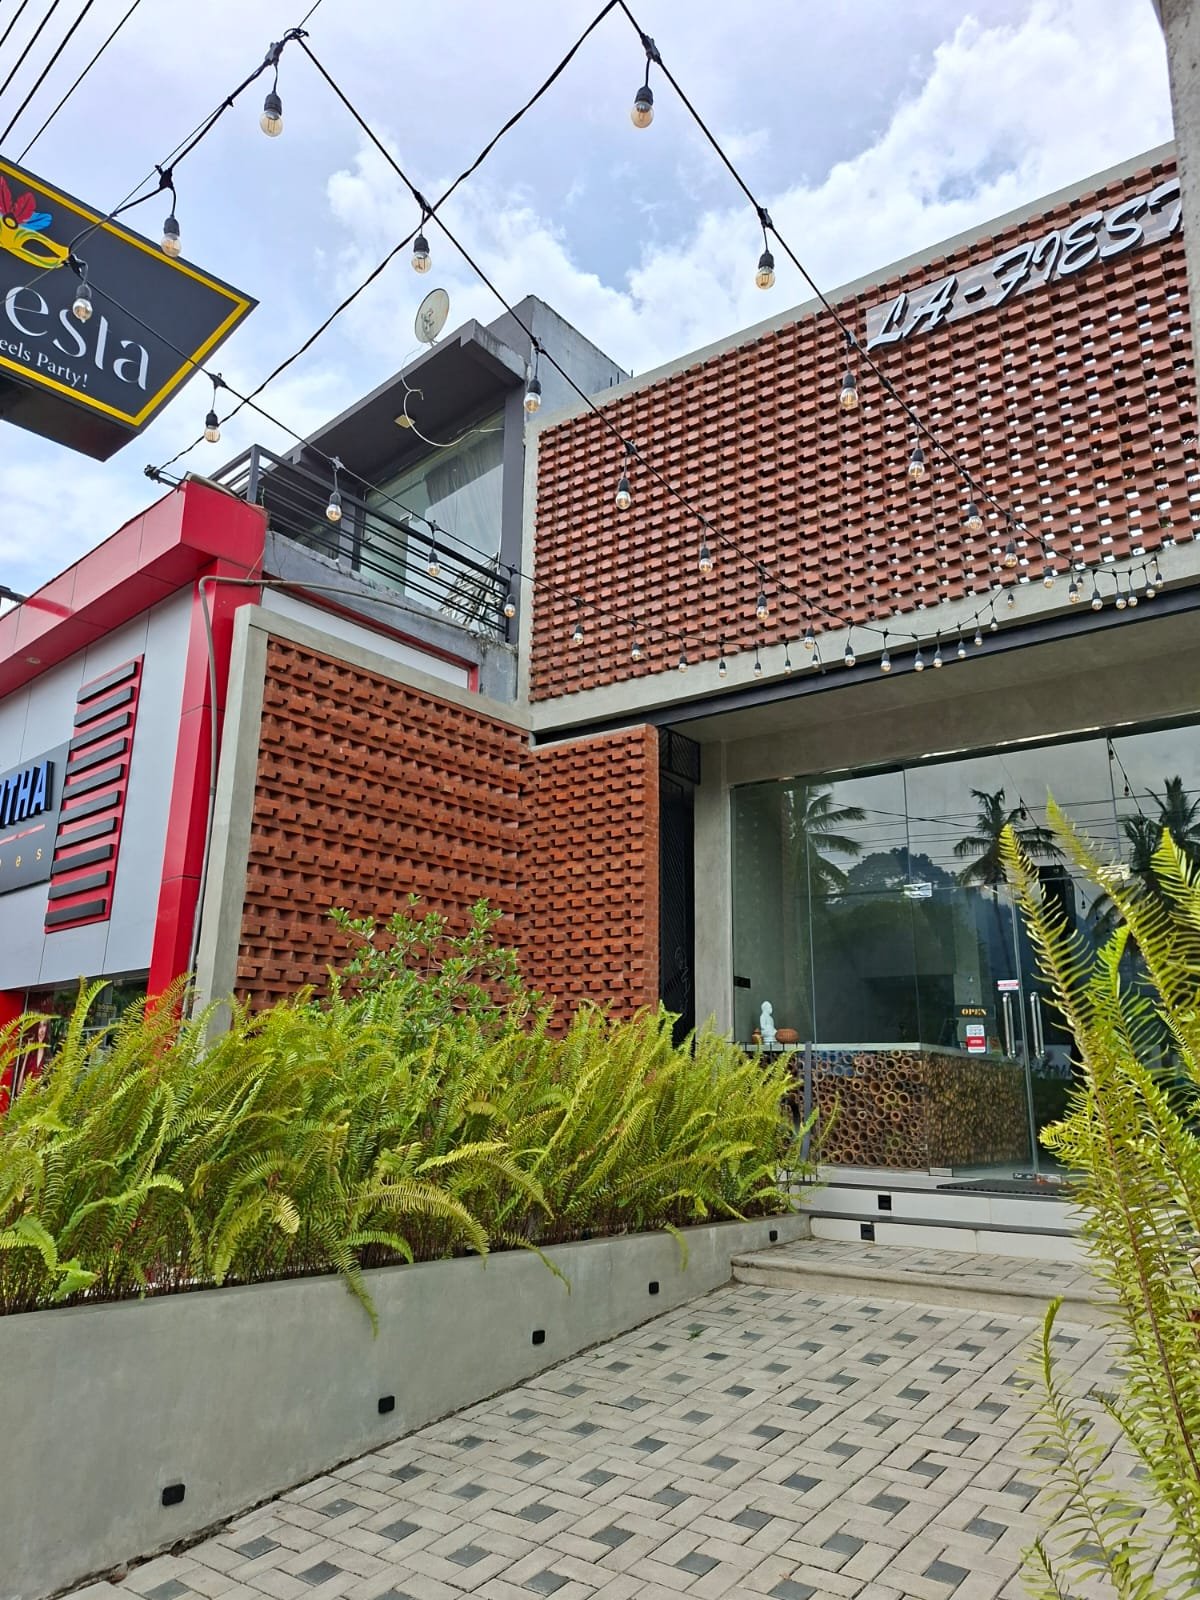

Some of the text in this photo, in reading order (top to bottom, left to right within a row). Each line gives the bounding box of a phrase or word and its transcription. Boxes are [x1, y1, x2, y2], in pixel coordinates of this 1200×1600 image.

[37, 352, 88, 388] Party!
[0, 760, 50, 826] THA
[961, 1008, 987, 1016] OPEN
